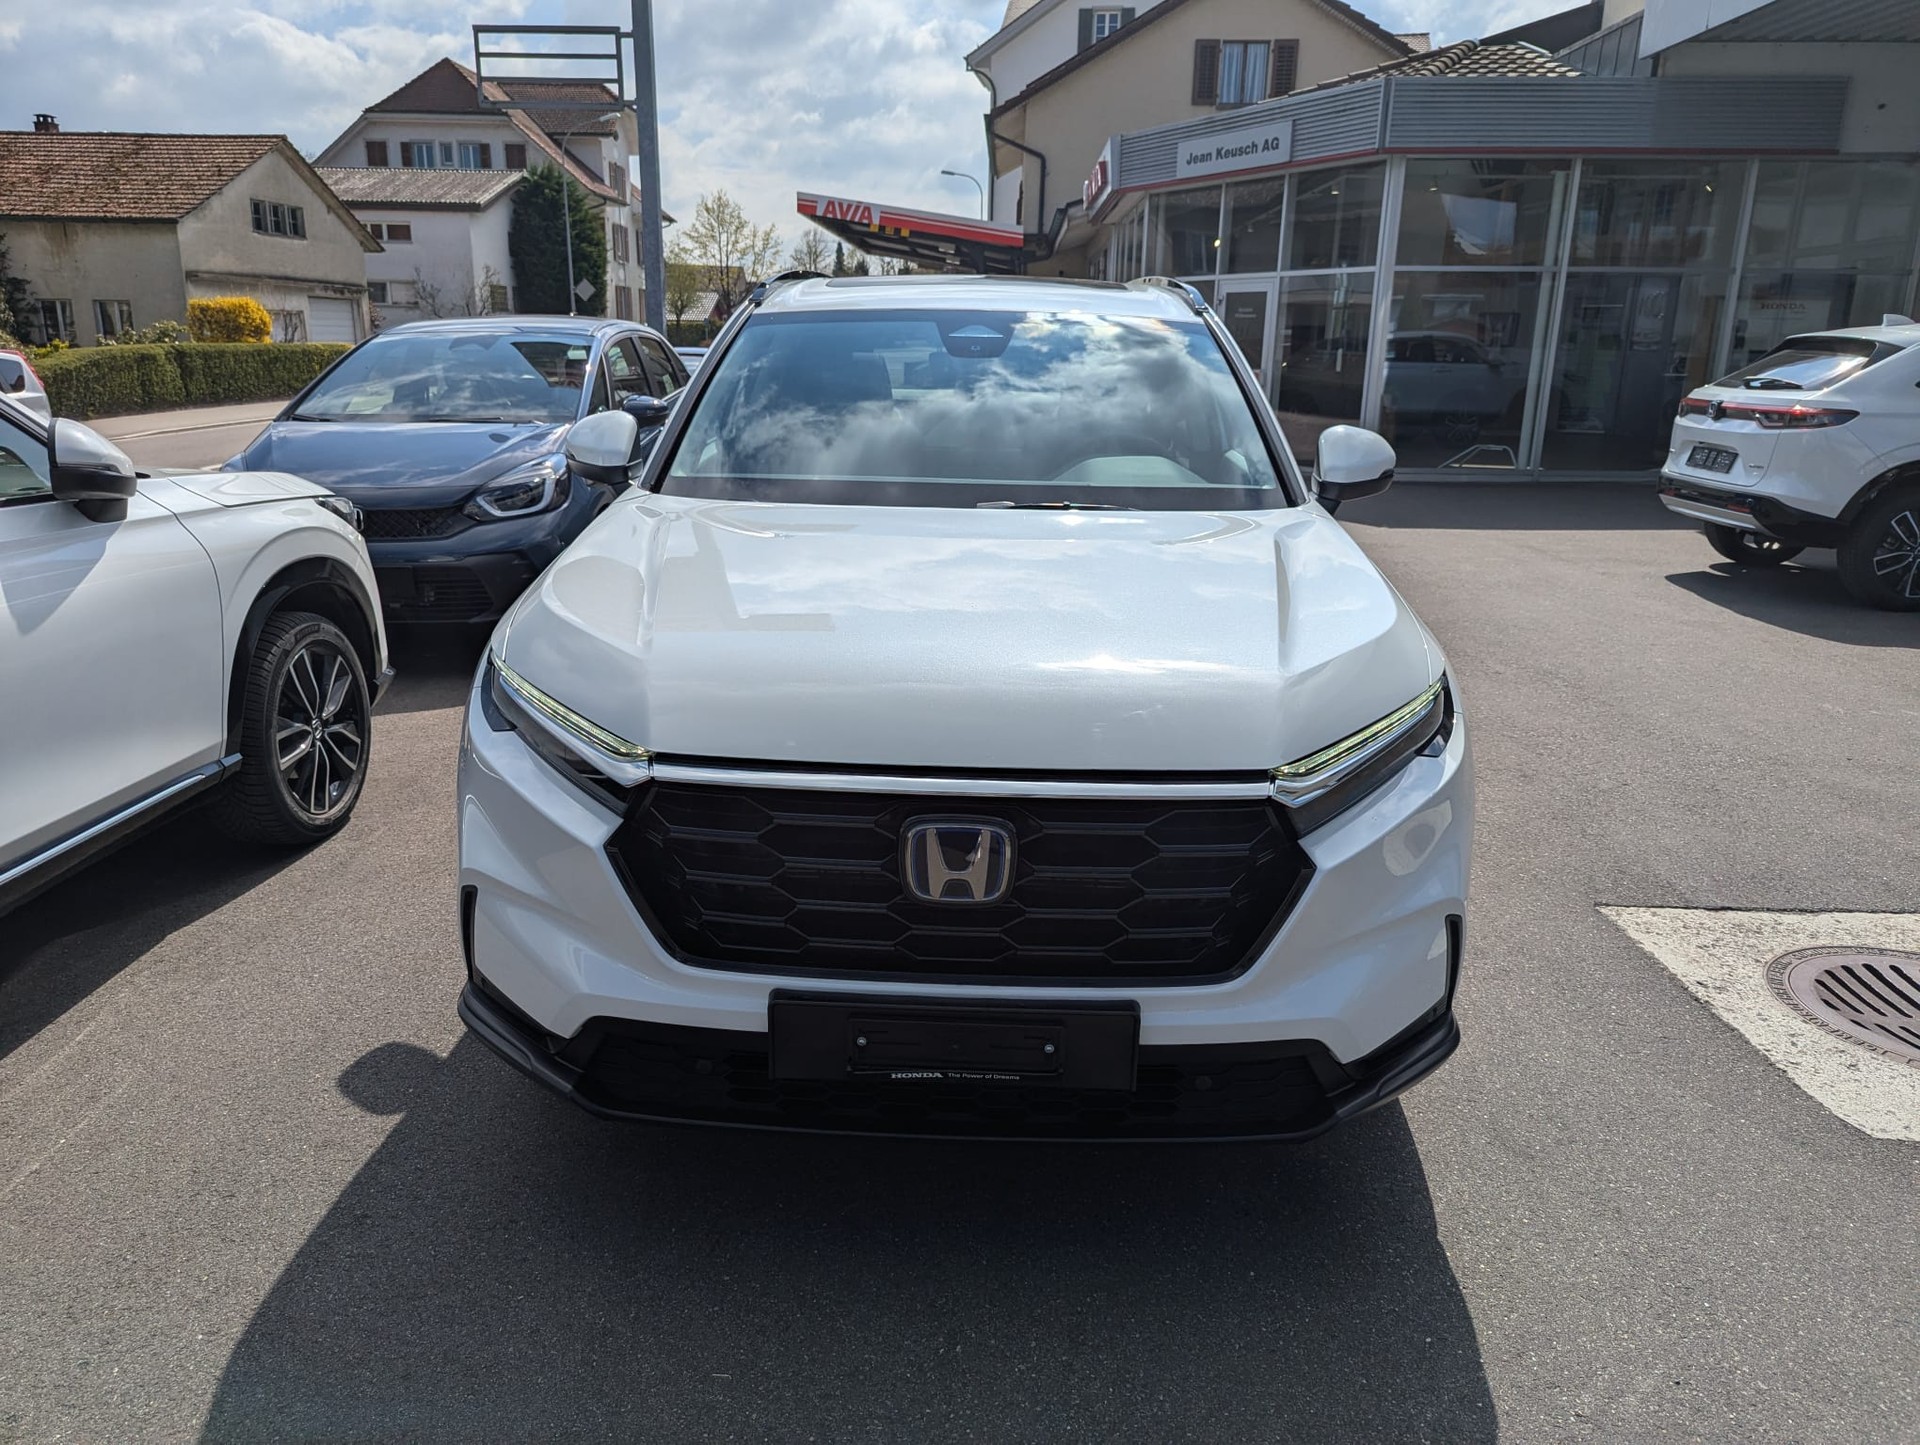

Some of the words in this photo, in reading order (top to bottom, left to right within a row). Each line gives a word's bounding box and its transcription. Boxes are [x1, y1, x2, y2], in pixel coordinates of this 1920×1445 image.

[1186, 152, 1213, 166] Jean
[1215, 141, 1259, 161] Keusch
[1261, 137, 1281, 153] AG
[822, 198, 874, 224] AVIA
[1760, 302, 1807, 311] HONDA
